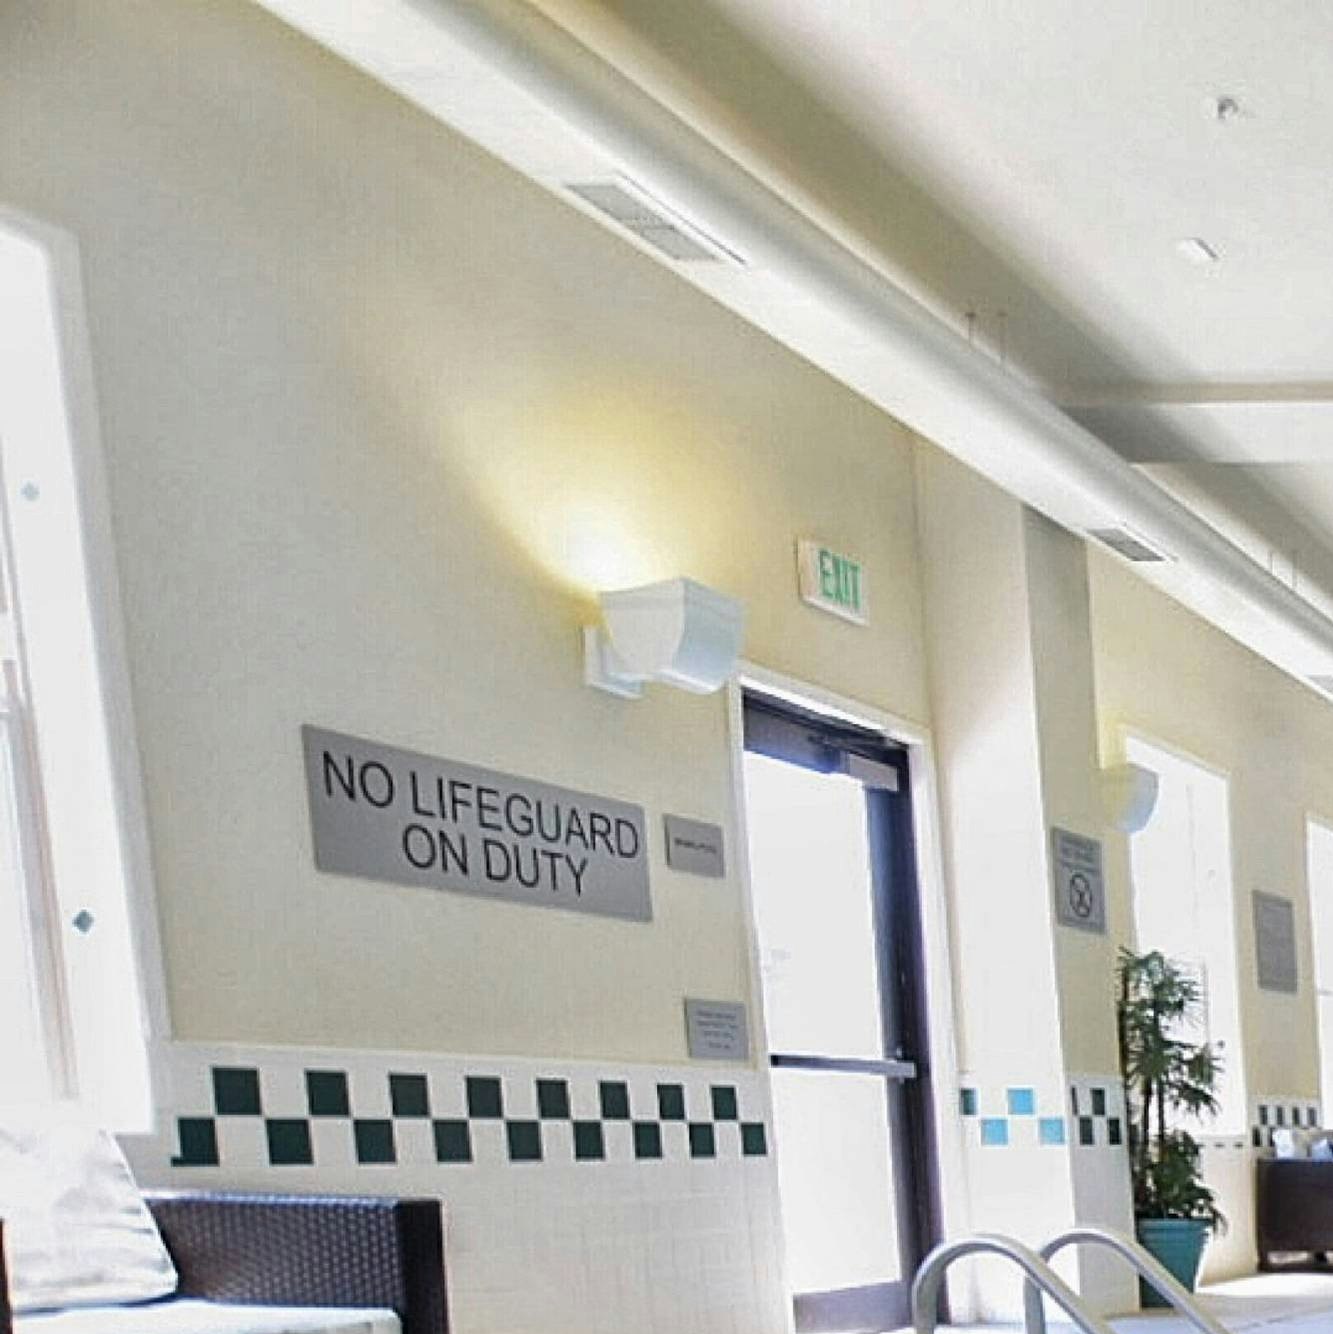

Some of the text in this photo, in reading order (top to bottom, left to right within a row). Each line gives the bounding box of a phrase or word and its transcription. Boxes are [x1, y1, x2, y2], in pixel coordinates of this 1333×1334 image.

[819, 549, 860, 609] EXIT
[323, 750, 639, 859] NO LIFEGUARD
[403, 823, 589, 897] ON DUTY
